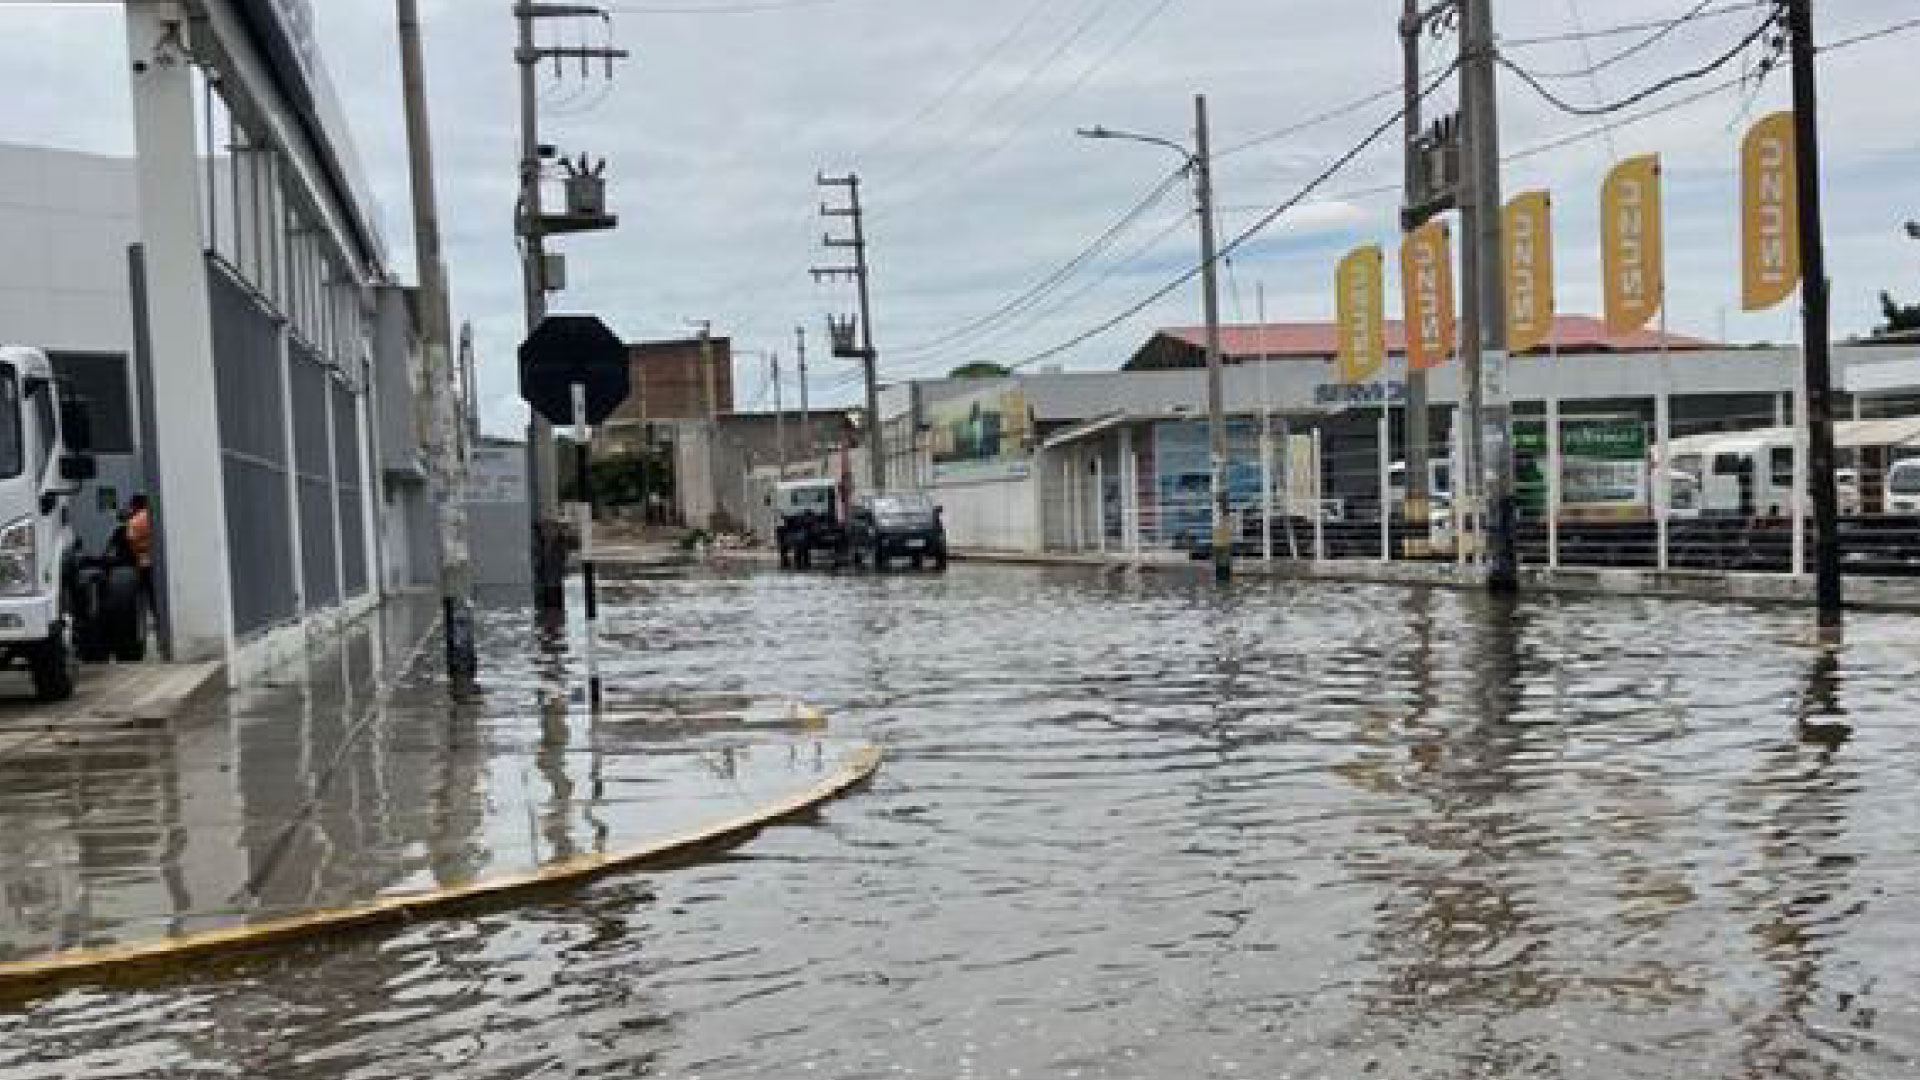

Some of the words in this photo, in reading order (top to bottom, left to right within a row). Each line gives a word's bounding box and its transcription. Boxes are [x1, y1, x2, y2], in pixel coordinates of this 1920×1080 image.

[1512, 212, 1534, 331] ISUZU
[1617, 178, 1645, 308] ISUZU
[1759, 137, 1786, 283] ISUZU
[1416, 242, 1442, 348] ISUZU
